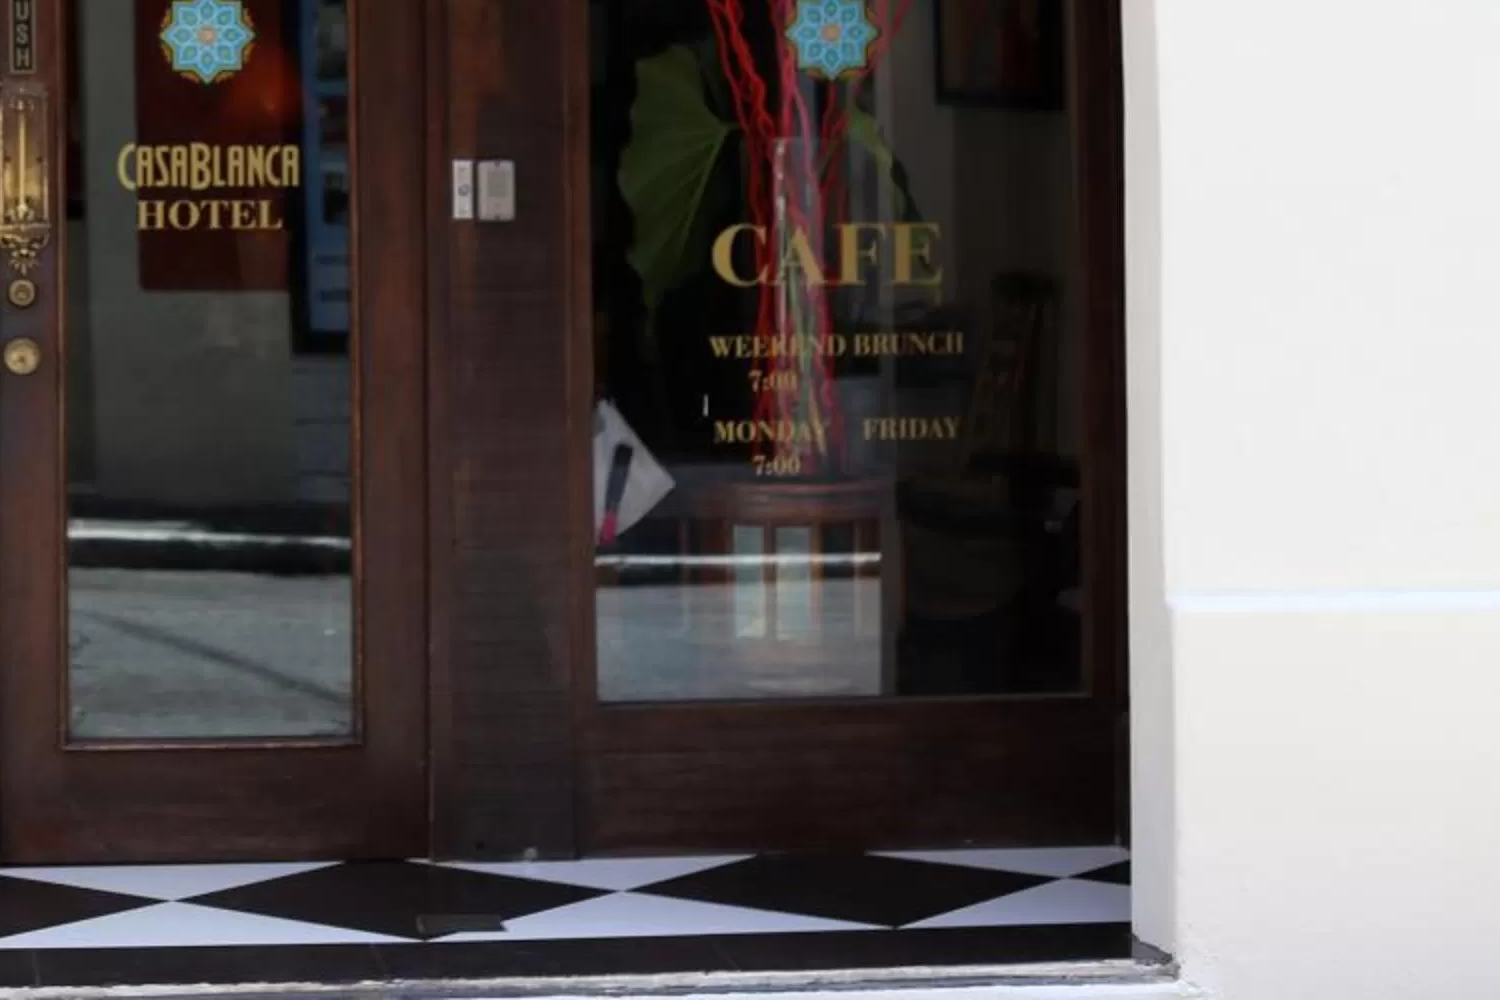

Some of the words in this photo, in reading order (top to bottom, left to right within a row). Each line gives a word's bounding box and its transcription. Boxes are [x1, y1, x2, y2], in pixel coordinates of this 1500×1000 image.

[117, 143, 300, 190] CASABLANCA
[136, 200, 283, 231] HOTEL
[711, 222, 943, 289] CAFE
[854, 332, 964, 355] BRUNCH
[713, 420, 825, 444] MONDAY
[863, 416, 960, 440] FRIDAY
[752, 455, 801, 475] 7:00
